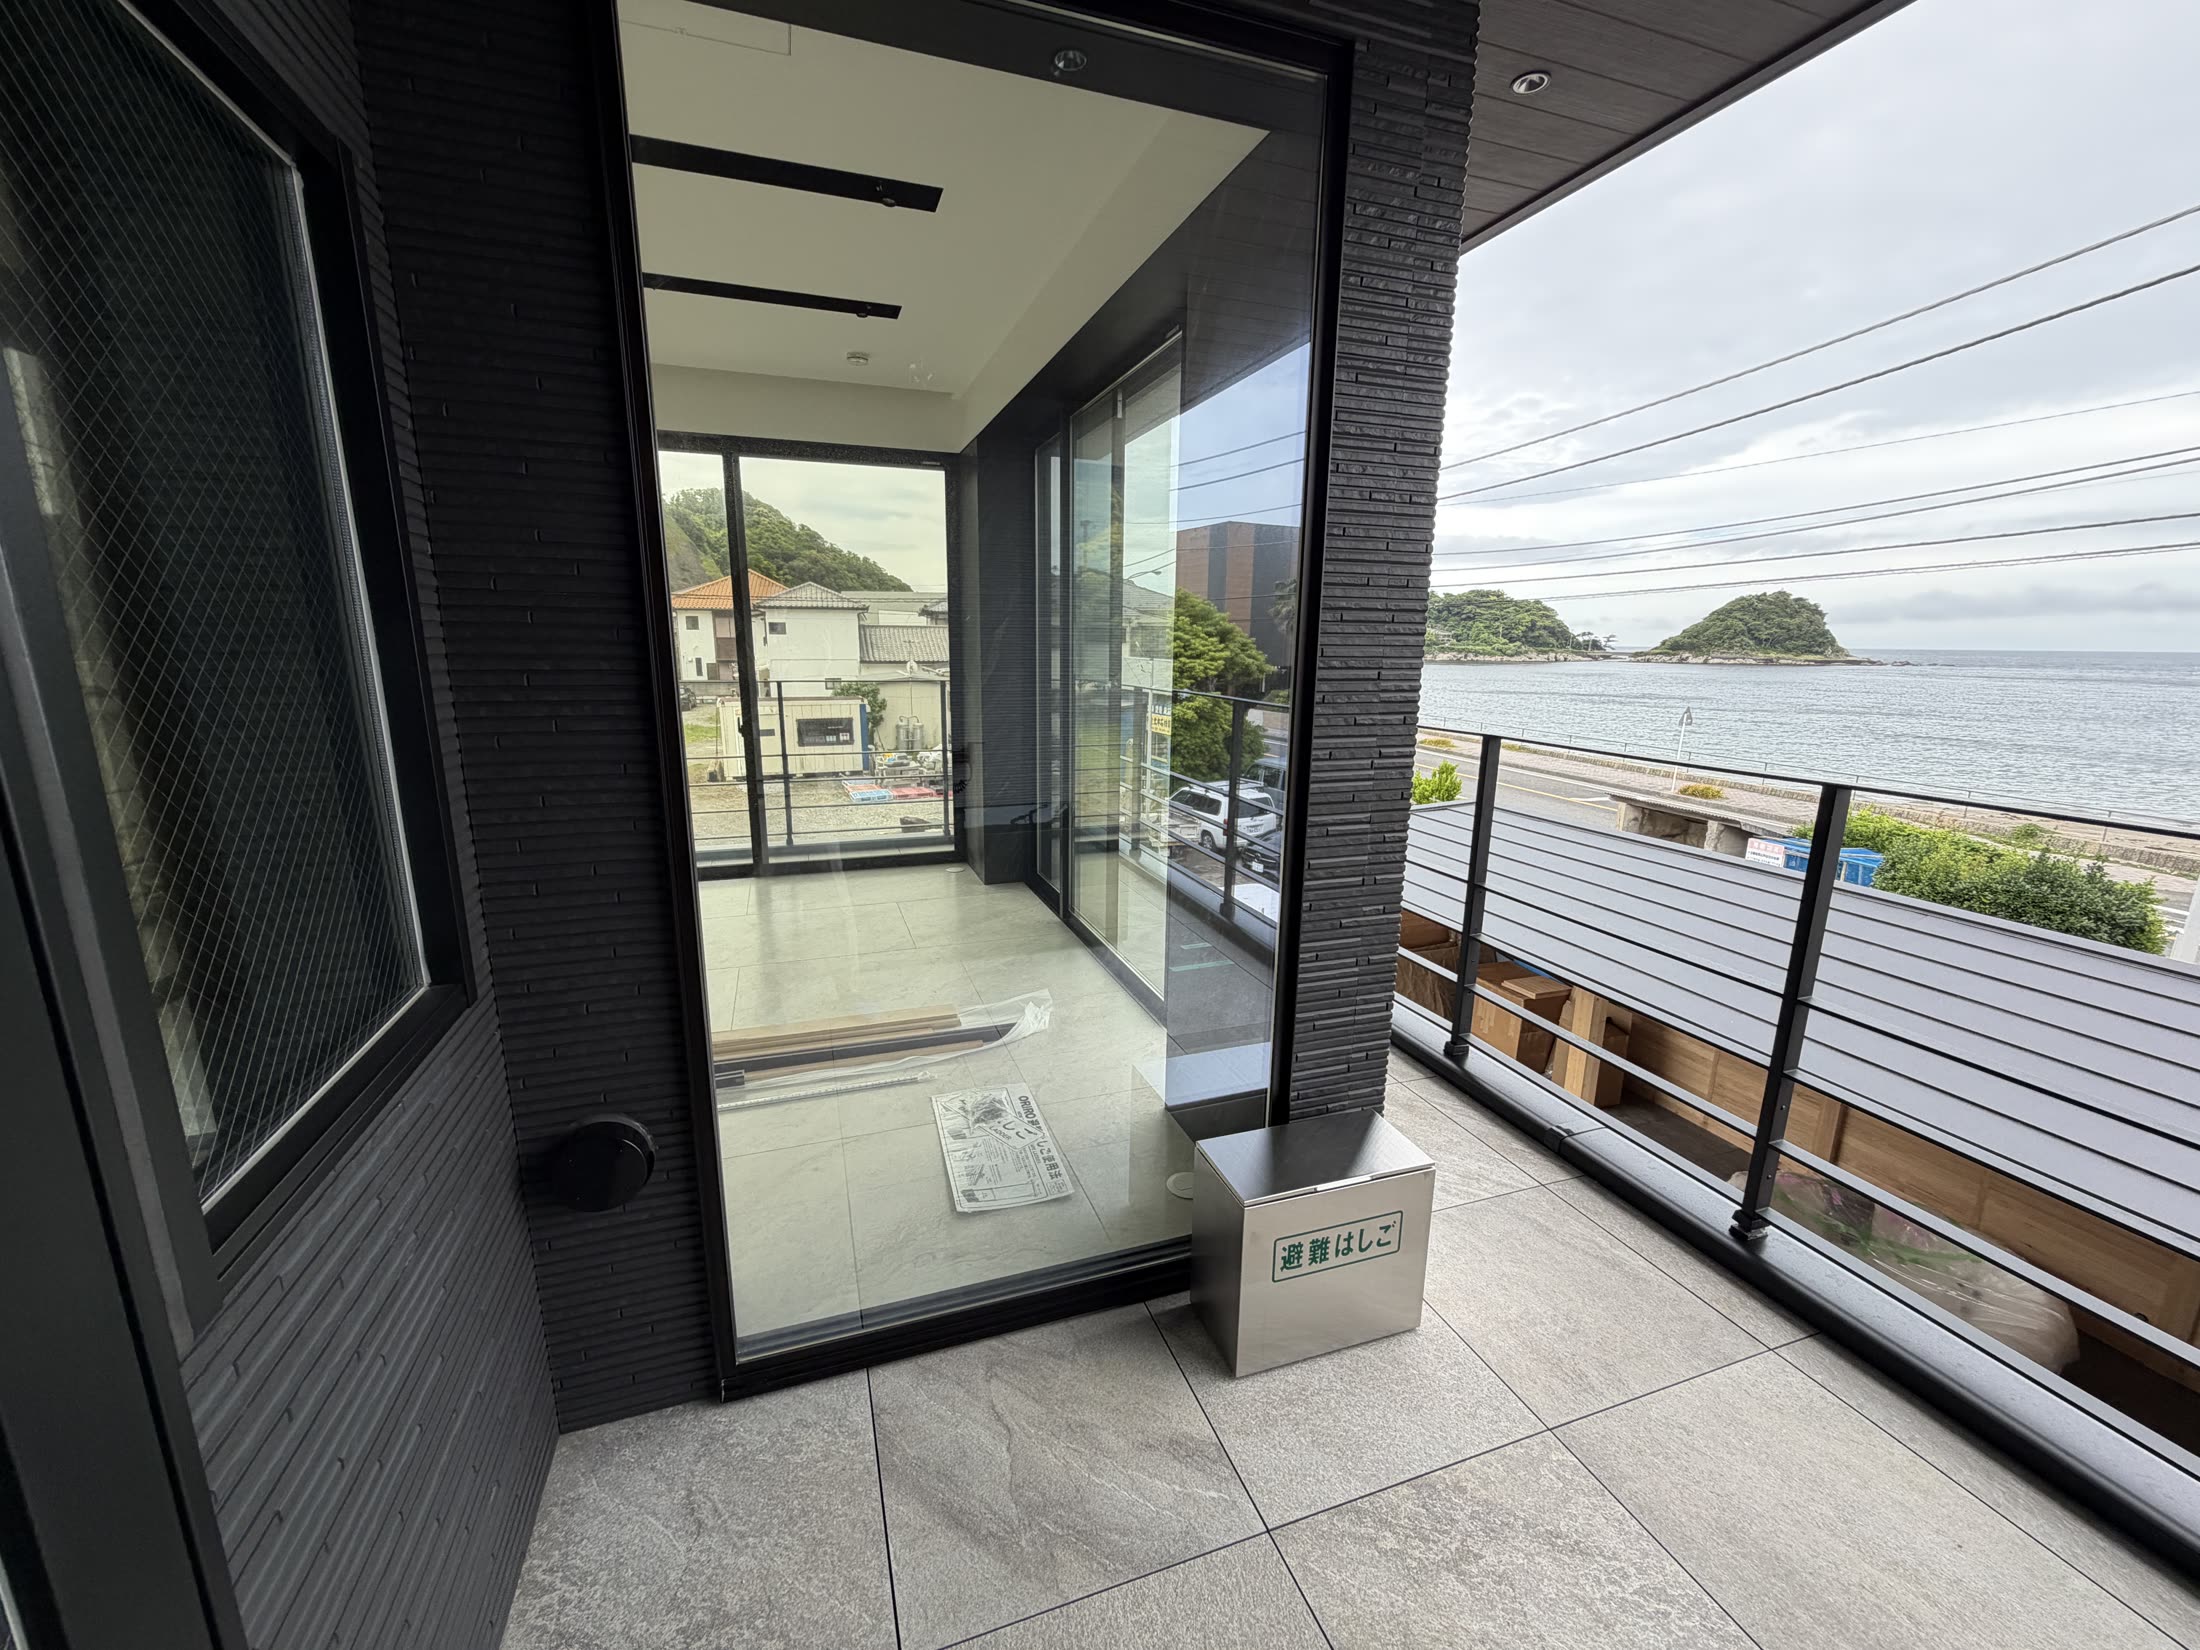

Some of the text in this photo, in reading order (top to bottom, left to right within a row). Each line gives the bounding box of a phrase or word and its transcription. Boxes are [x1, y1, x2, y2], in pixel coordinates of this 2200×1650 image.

[1280, 1220, 1397, 1272] 避難はしご
